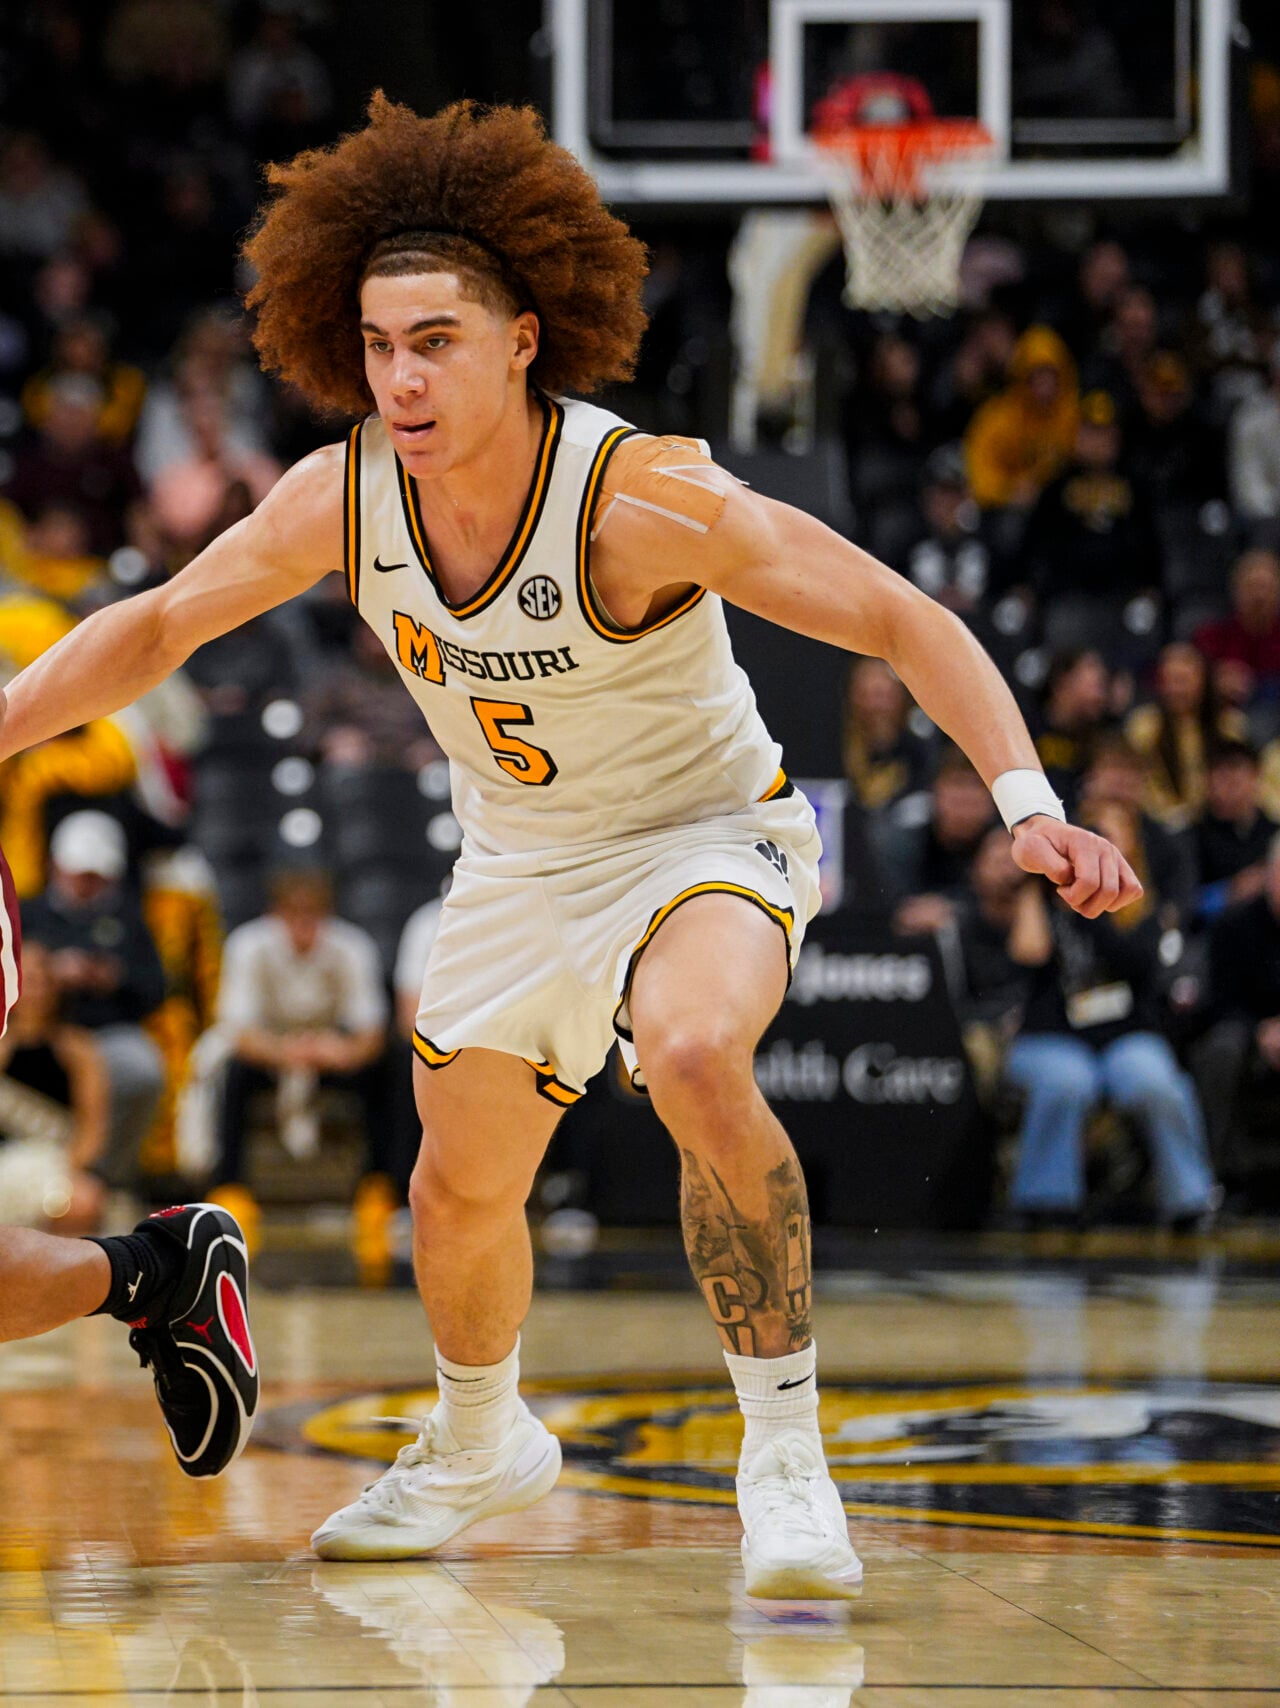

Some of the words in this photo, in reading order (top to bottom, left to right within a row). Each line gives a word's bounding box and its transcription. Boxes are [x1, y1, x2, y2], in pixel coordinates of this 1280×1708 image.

[519, 577, 561, 619] SEC
[392, 610, 580, 687] MISSOURI
[470, 696, 559, 787] 5
[842, 1041, 963, 1105] Care
